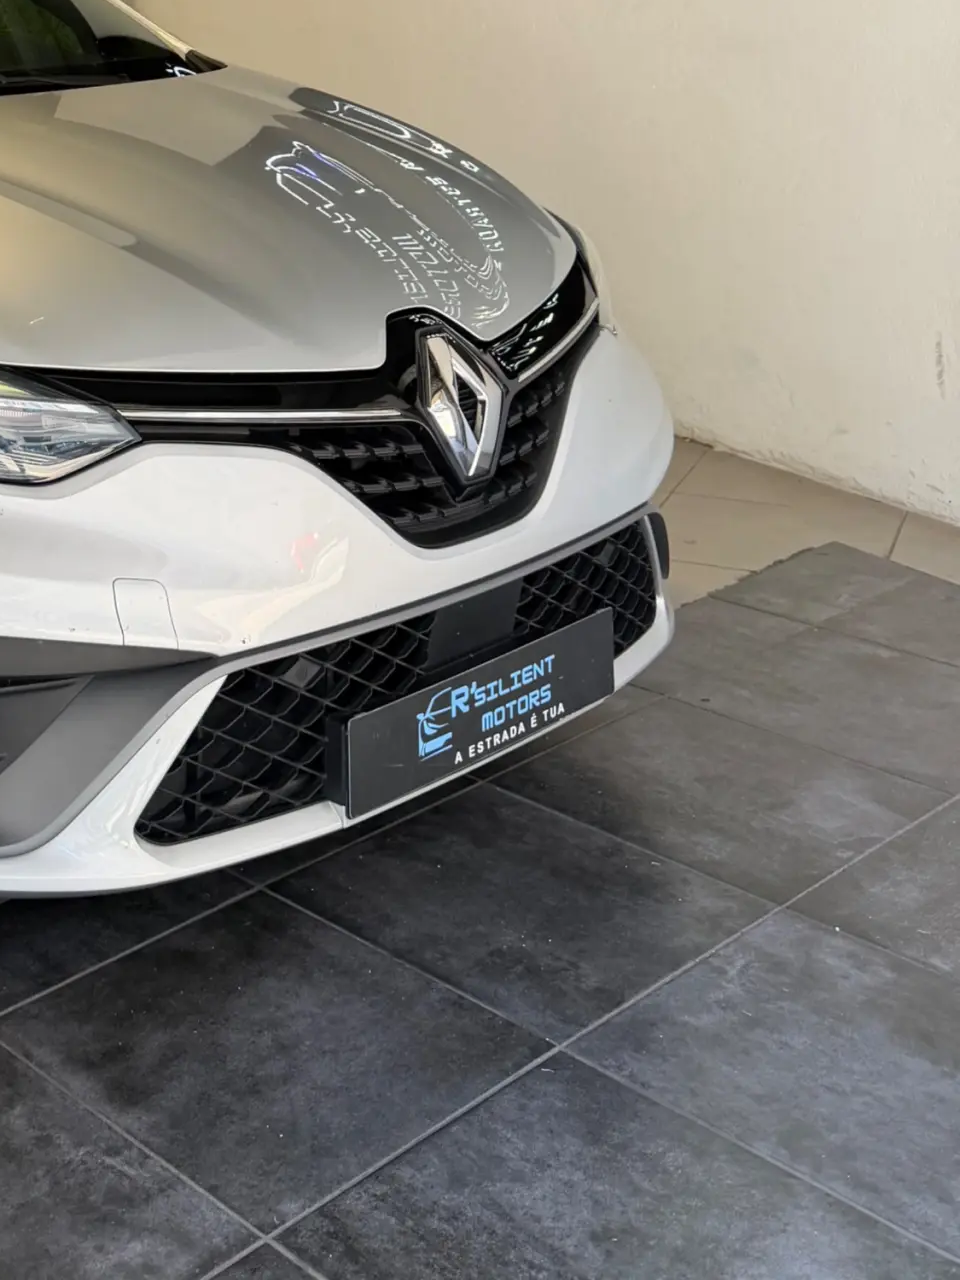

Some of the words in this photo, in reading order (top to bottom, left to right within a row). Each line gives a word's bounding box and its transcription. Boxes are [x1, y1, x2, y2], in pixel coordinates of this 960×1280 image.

[451, 654, 556, 718] R'SILIENT
[481, 683, 552, 732] MOTORS
[454, 751, 463, 765] A
[468, 722, 526, 758] ESTRADA
[530, 713, 538, 729] É
[542, 702, 566, 722] TUA
